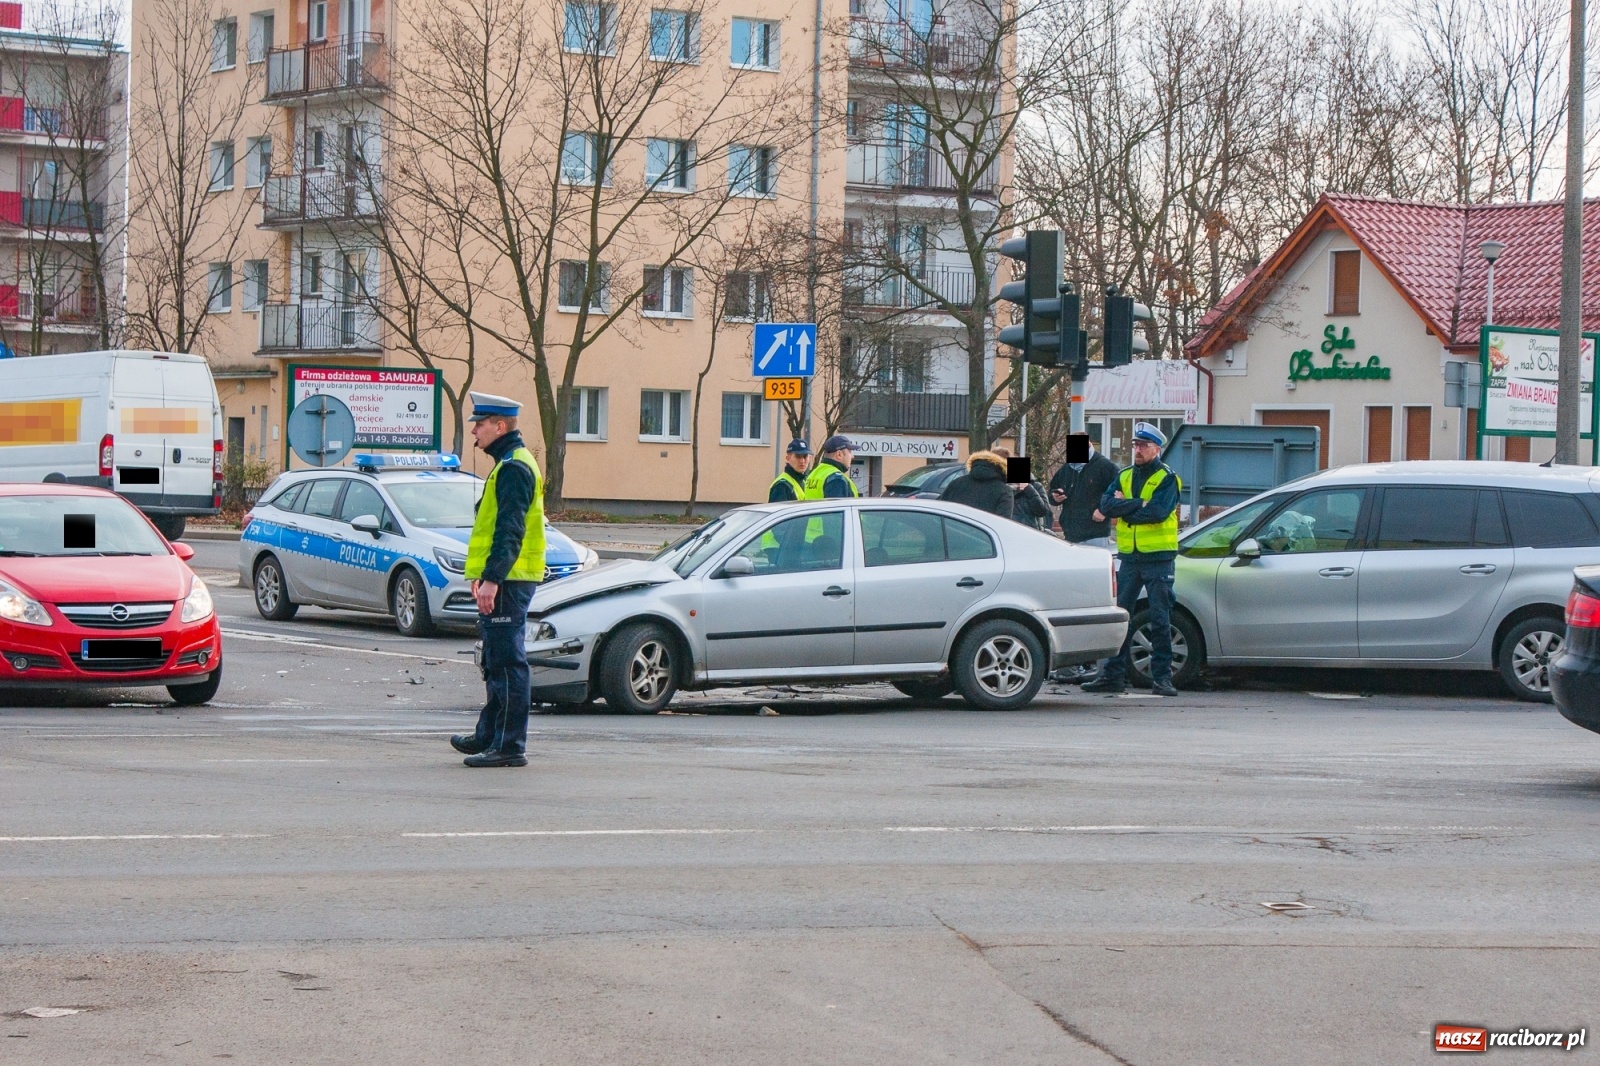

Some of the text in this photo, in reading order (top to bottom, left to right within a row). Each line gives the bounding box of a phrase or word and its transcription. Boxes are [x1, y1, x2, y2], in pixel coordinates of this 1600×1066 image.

[1537, 352, 1560, 372] Odr
[301, 370, 428, 383] Firma odzieżowa SAMURAJ
[300, 381, 429, 392] oferuje ubrania polskich producentów
[771, 382, 795, 395] 935
[1507, 382, 1532, 401] ZMIANA
[349, 393, 384, 402] damskie
[350, 404, 380, 413] męskie
[353, 414, 384, 424] iecięce
[359, 425, 404, 433] rozmiarach
[392, 435, 429, 444] Racibórz
[881, 441, 903, 453] DLA
[907, 441, 939, 454] PSÓW
[395, 456, 429, 466] POLICJA
[339, 544, 377, 567] POLICJA
